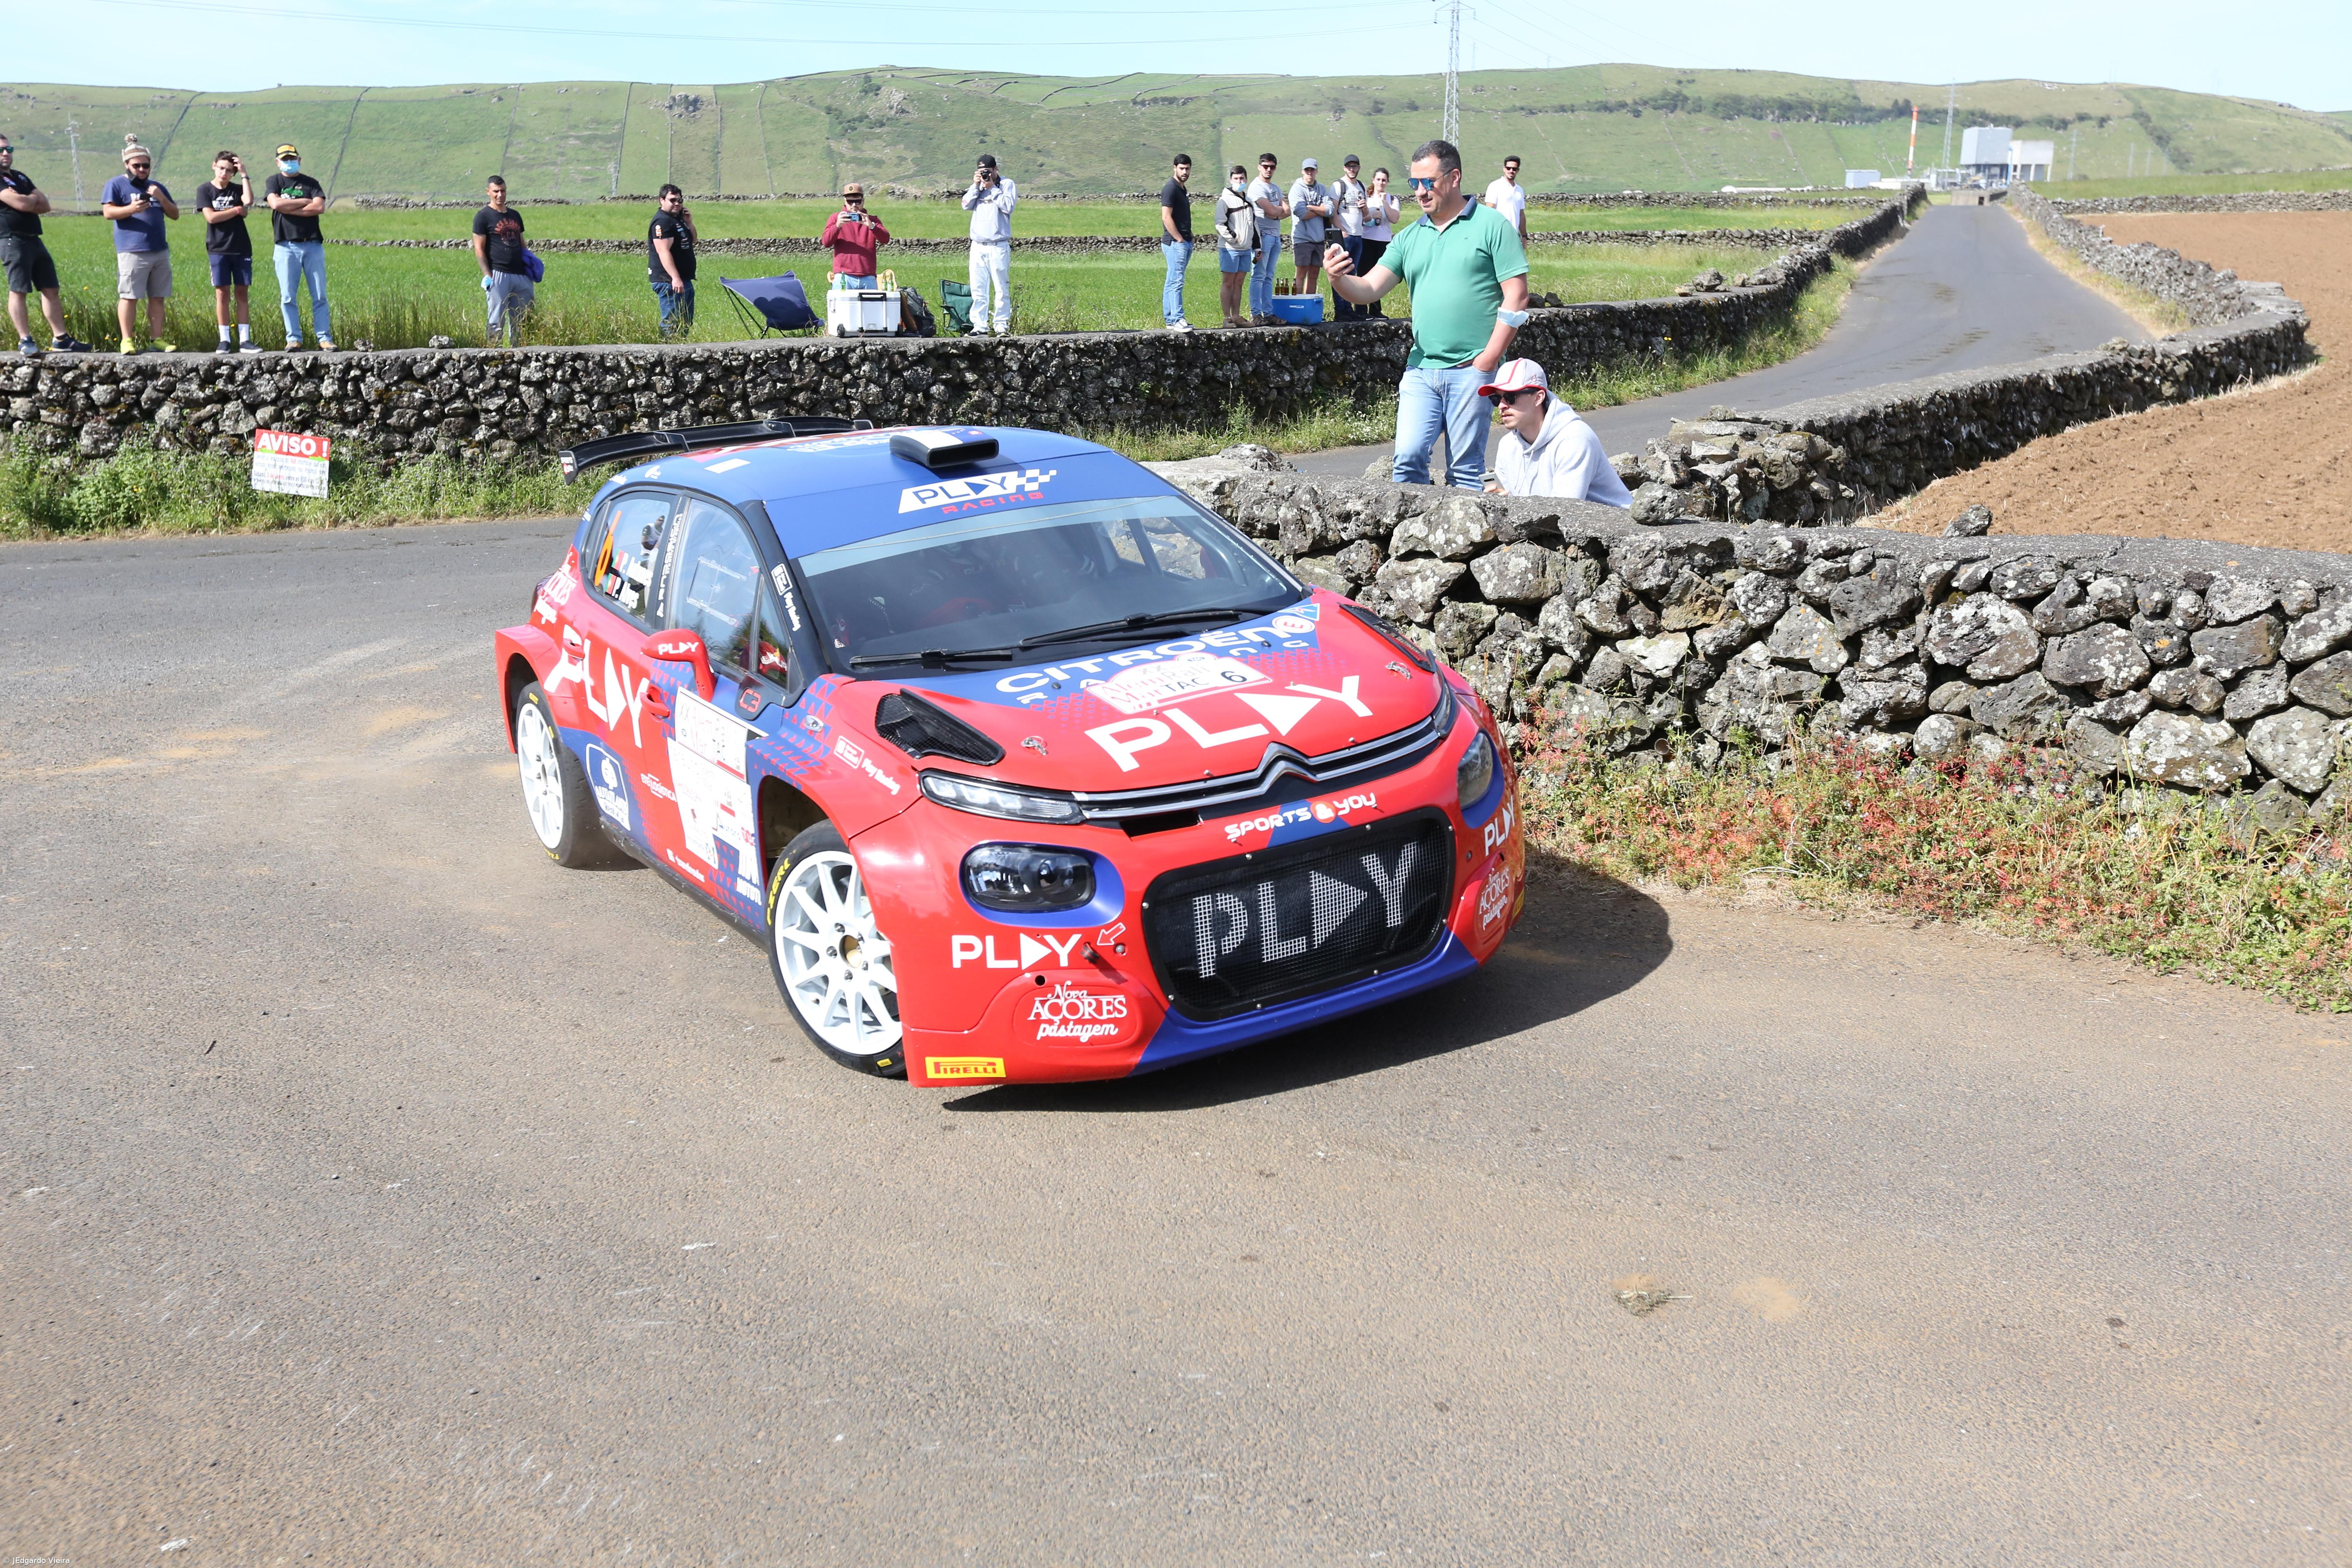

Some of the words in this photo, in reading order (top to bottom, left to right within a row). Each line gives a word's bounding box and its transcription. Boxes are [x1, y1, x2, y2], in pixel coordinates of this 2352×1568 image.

[257, 433, 316, 455] AVISO
[941, 492, 1044, 514] RACING
[995, 626, 1292, 693] CITROËN
[1160, 677, 1209, 692] TAC
[1220, 670, 1247, 683] 6
[739, 687, 762, 713] C3
[1224, 806, 1312, 840] SPORTS
[1336, 792, 1376, 819] YOU
[1479, 869, 1510, 915] AÇORES
[1047, 980, 1088, 1004] Nova
[1027, 998, 1128, 1025] AÇORES
[1036, 1020, 1118, 1043] pastagem
[933, 1061, 997, 1075] PIRELLI
